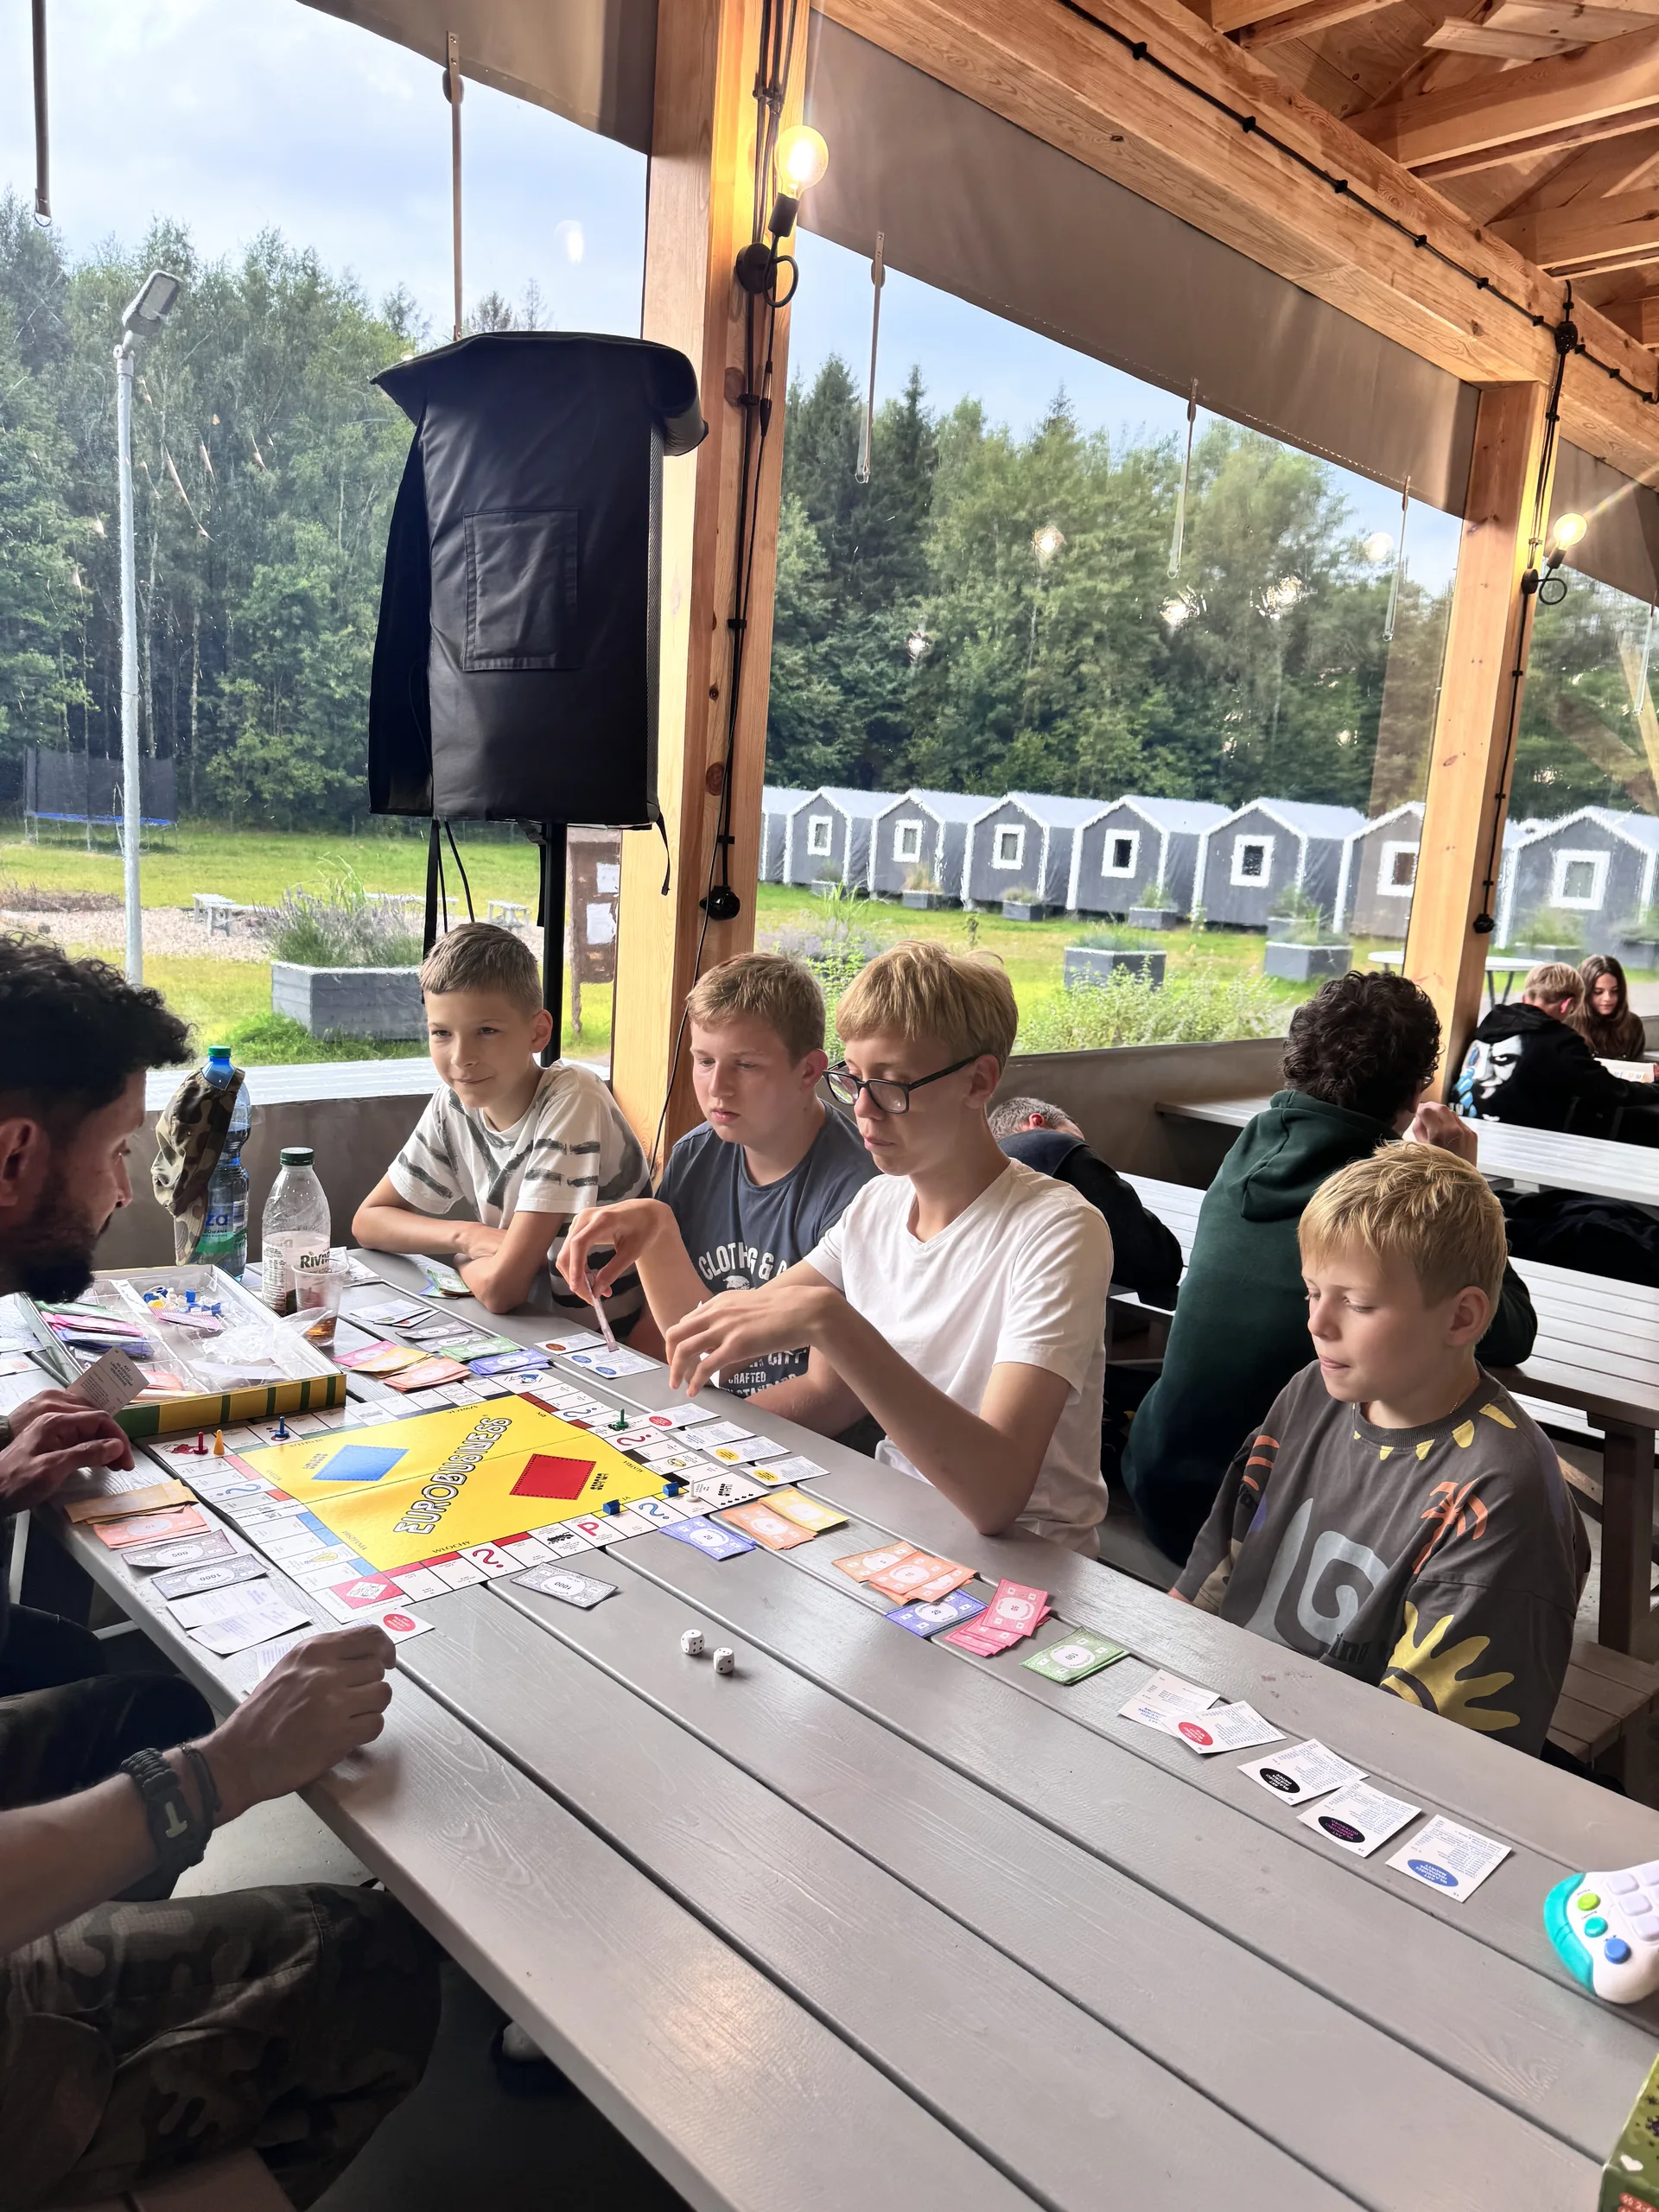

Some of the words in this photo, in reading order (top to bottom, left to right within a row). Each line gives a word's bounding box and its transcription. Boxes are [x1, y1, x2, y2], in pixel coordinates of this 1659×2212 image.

[392, 1417, 512, 1534] EUROBUSINESS
[200, 1573, 221, 1582] 1000
[554, 1580, 571, 1591] 1000
[1065, 1652, 1078, 1661] 100
